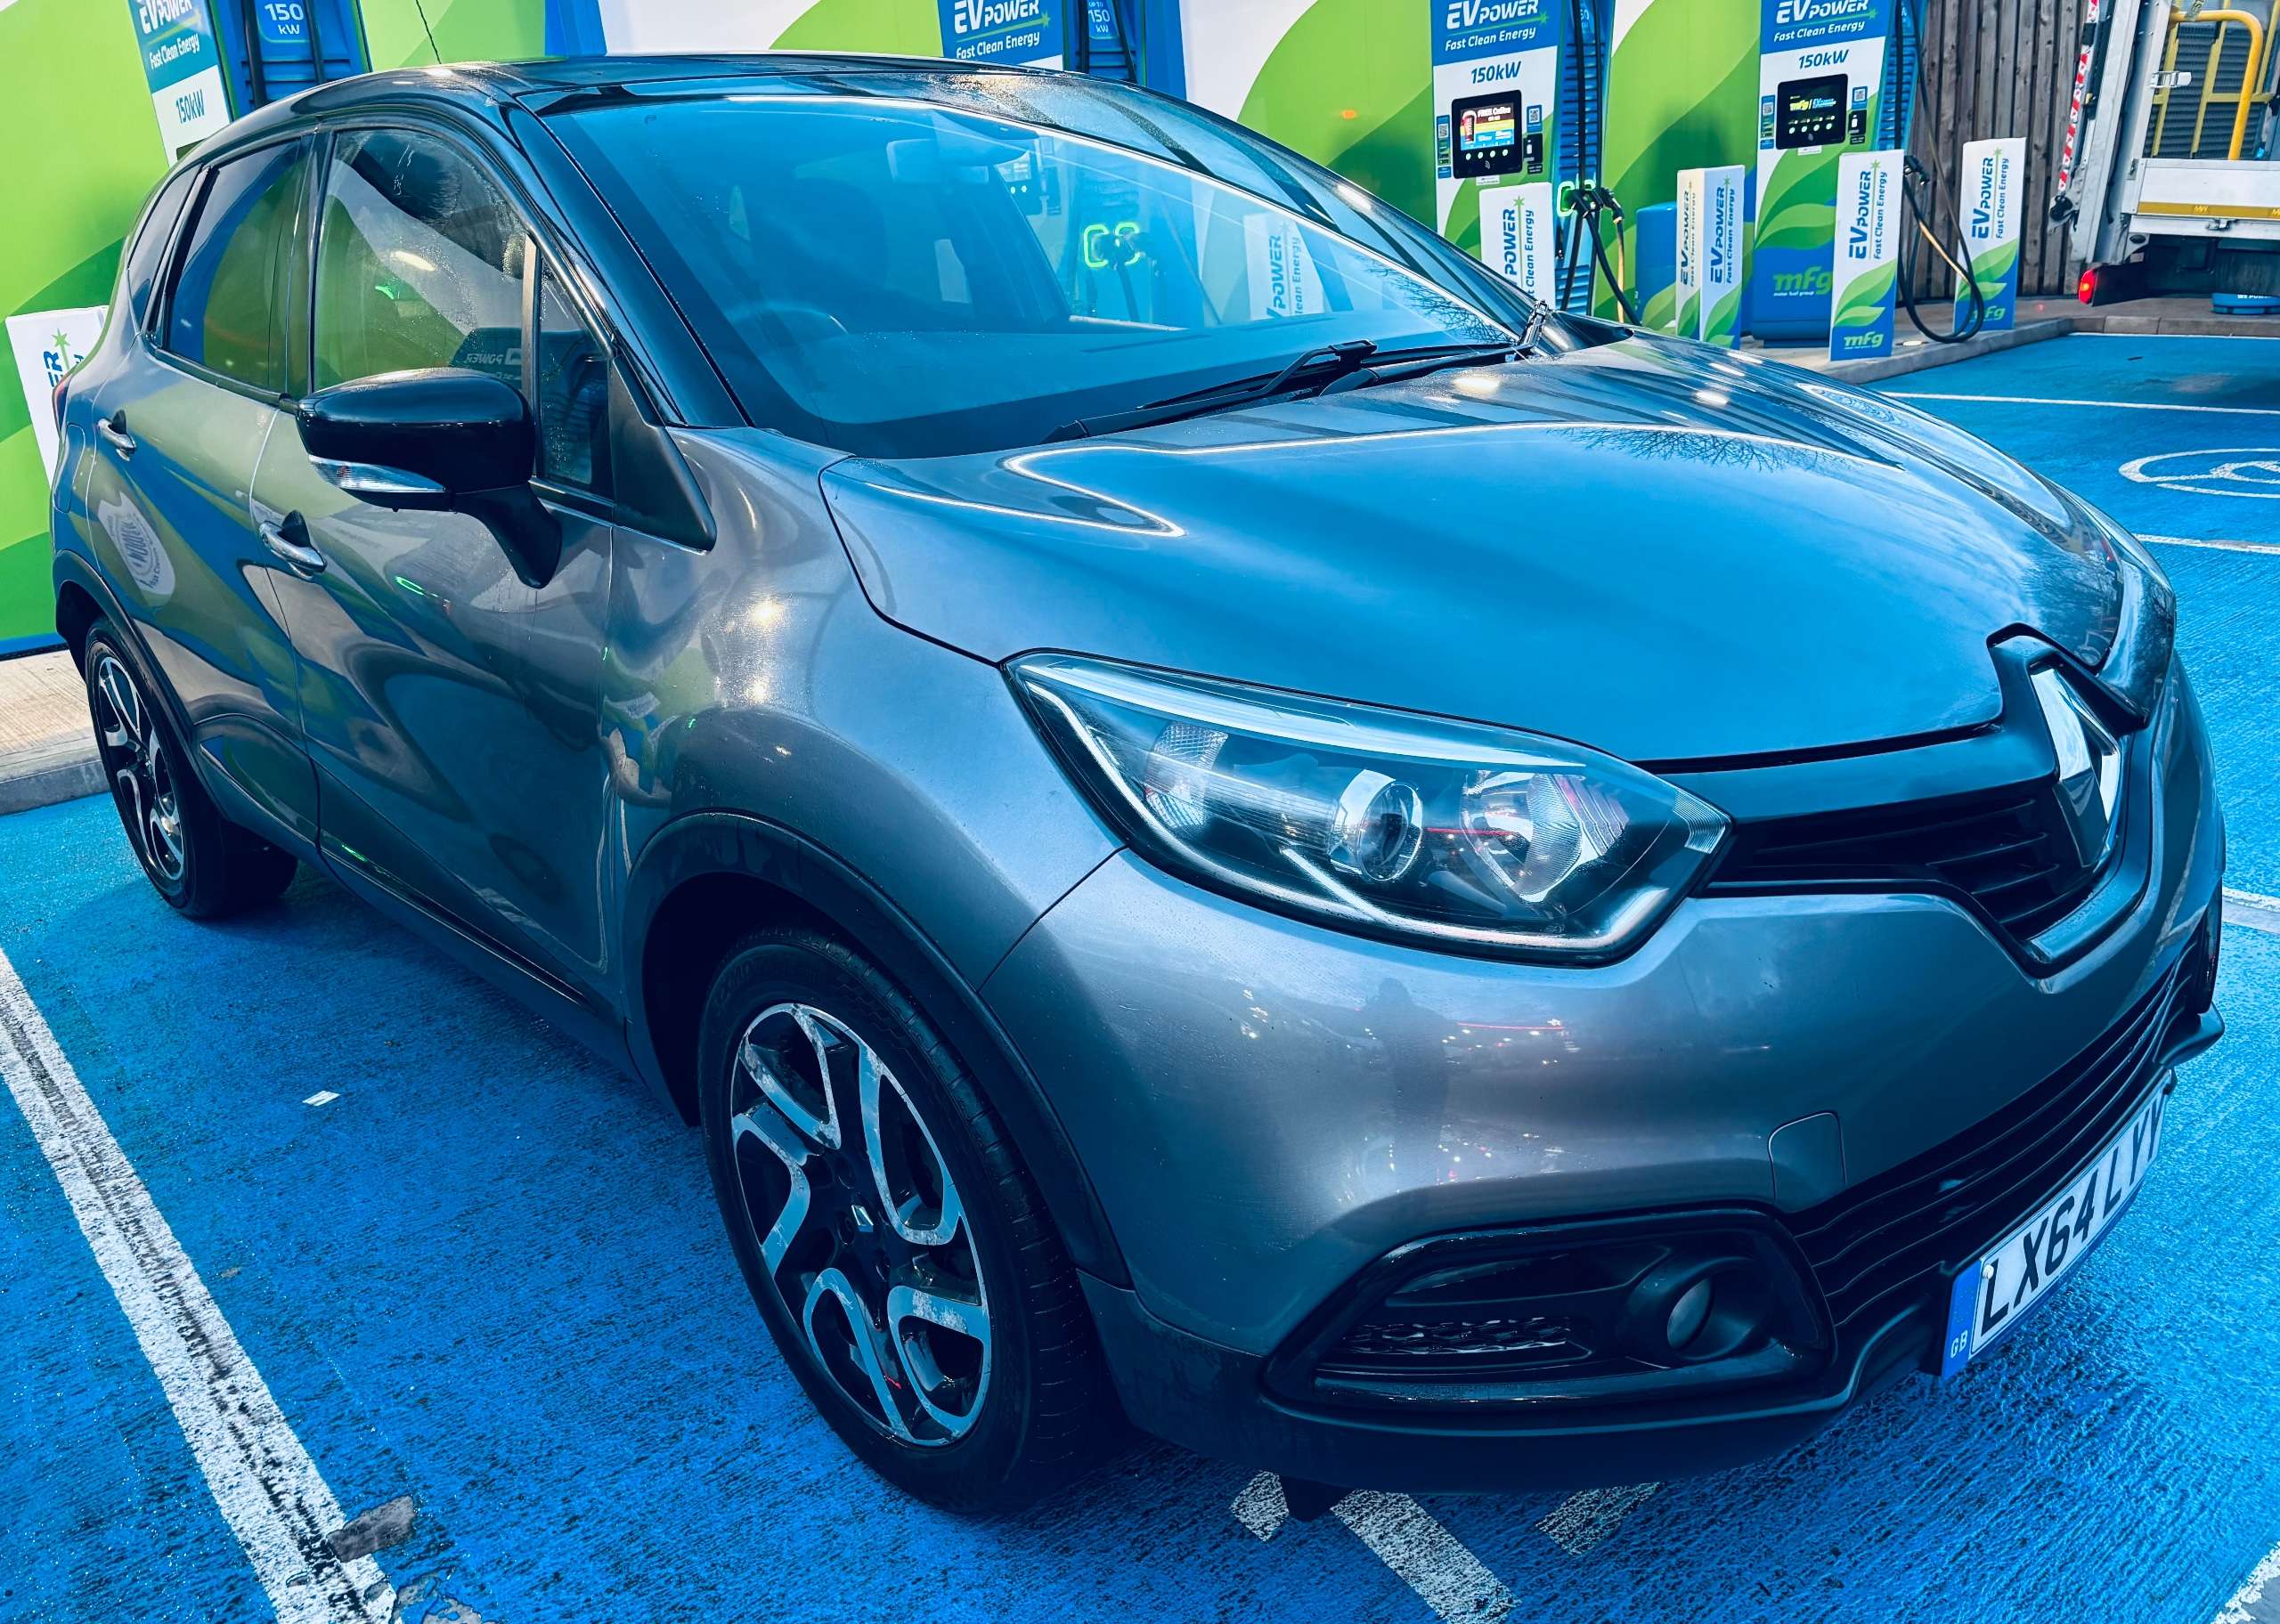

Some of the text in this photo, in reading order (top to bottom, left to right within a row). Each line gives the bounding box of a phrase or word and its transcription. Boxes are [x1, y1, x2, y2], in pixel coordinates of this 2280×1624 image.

[265, 4, 304, 20] 150
[1088, 9, 1111, 22] 150
[1478, 0, 1538, 24] POWER
[277, 24, 300, 35] kW
[1095, 25, 1109, 33] kW
[1445, 27, 1536, 51] Fast Clean Energy
[1773, 20, 1865, 42] Fast Clean Energy
[149, 33, 200, 69] Fast Clean Energy
[956, 31, 1040, 60] Fast Clean Energy
[1798, 49, 1849, 69] 150kW
[1470, 61, 1522, 84] 150kW
[175, 90, 205, 124] 150kW
[1728, 188, 1736, 226] Energy
[1972, 157, 1993, 240] EV POWER
[1995, 158, 2009, 240] Fast Clean Energy
[1524, 209, 1535, 251] Energy
[1848, 170, 1871, 259] EV POWER
[1873, 172, 1887, 259] Fast Clean Energy
[1502, 208, 1517, 276] POWER
[1710, 187, 1725, 284] EV POWER
[1269, 235, 1286, 309] POWER
[1525, 255, 1535, 288] Clean
[1772, 266, 1833, 295] mfg
[1844, 331, 1884, 347] mfg
[1980, 1092, 2165, 1337] LX64 LYY
[1950, 1330, 1968, 1359] GB
